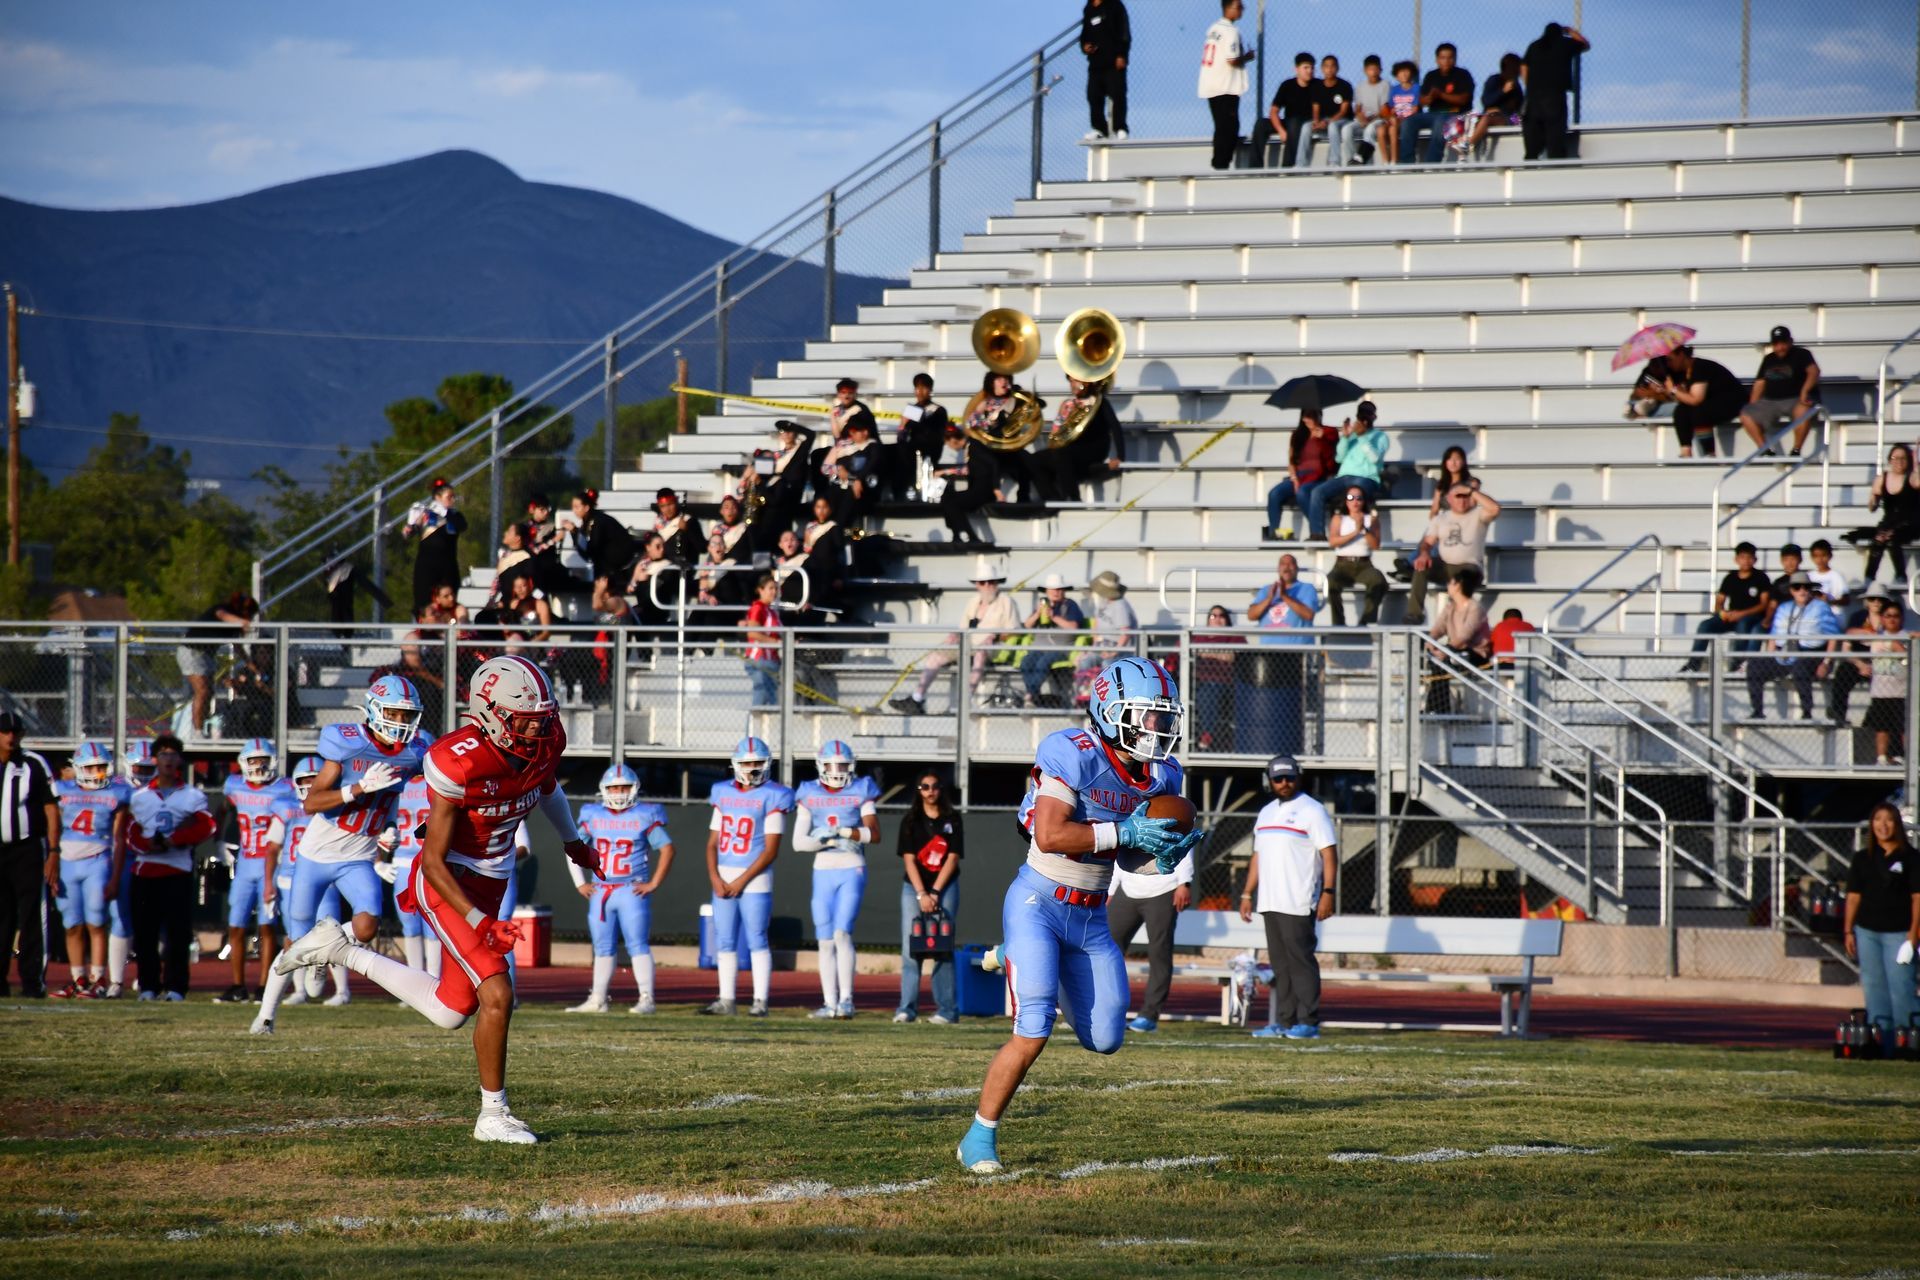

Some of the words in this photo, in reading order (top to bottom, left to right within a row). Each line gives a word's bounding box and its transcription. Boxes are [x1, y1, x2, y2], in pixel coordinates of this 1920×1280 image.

[481, 673, 500, 697] 2
[450, 737, 480, 756] 2
[71, 809, 95, 836] 4
[719, 815, 755, 855] 69
